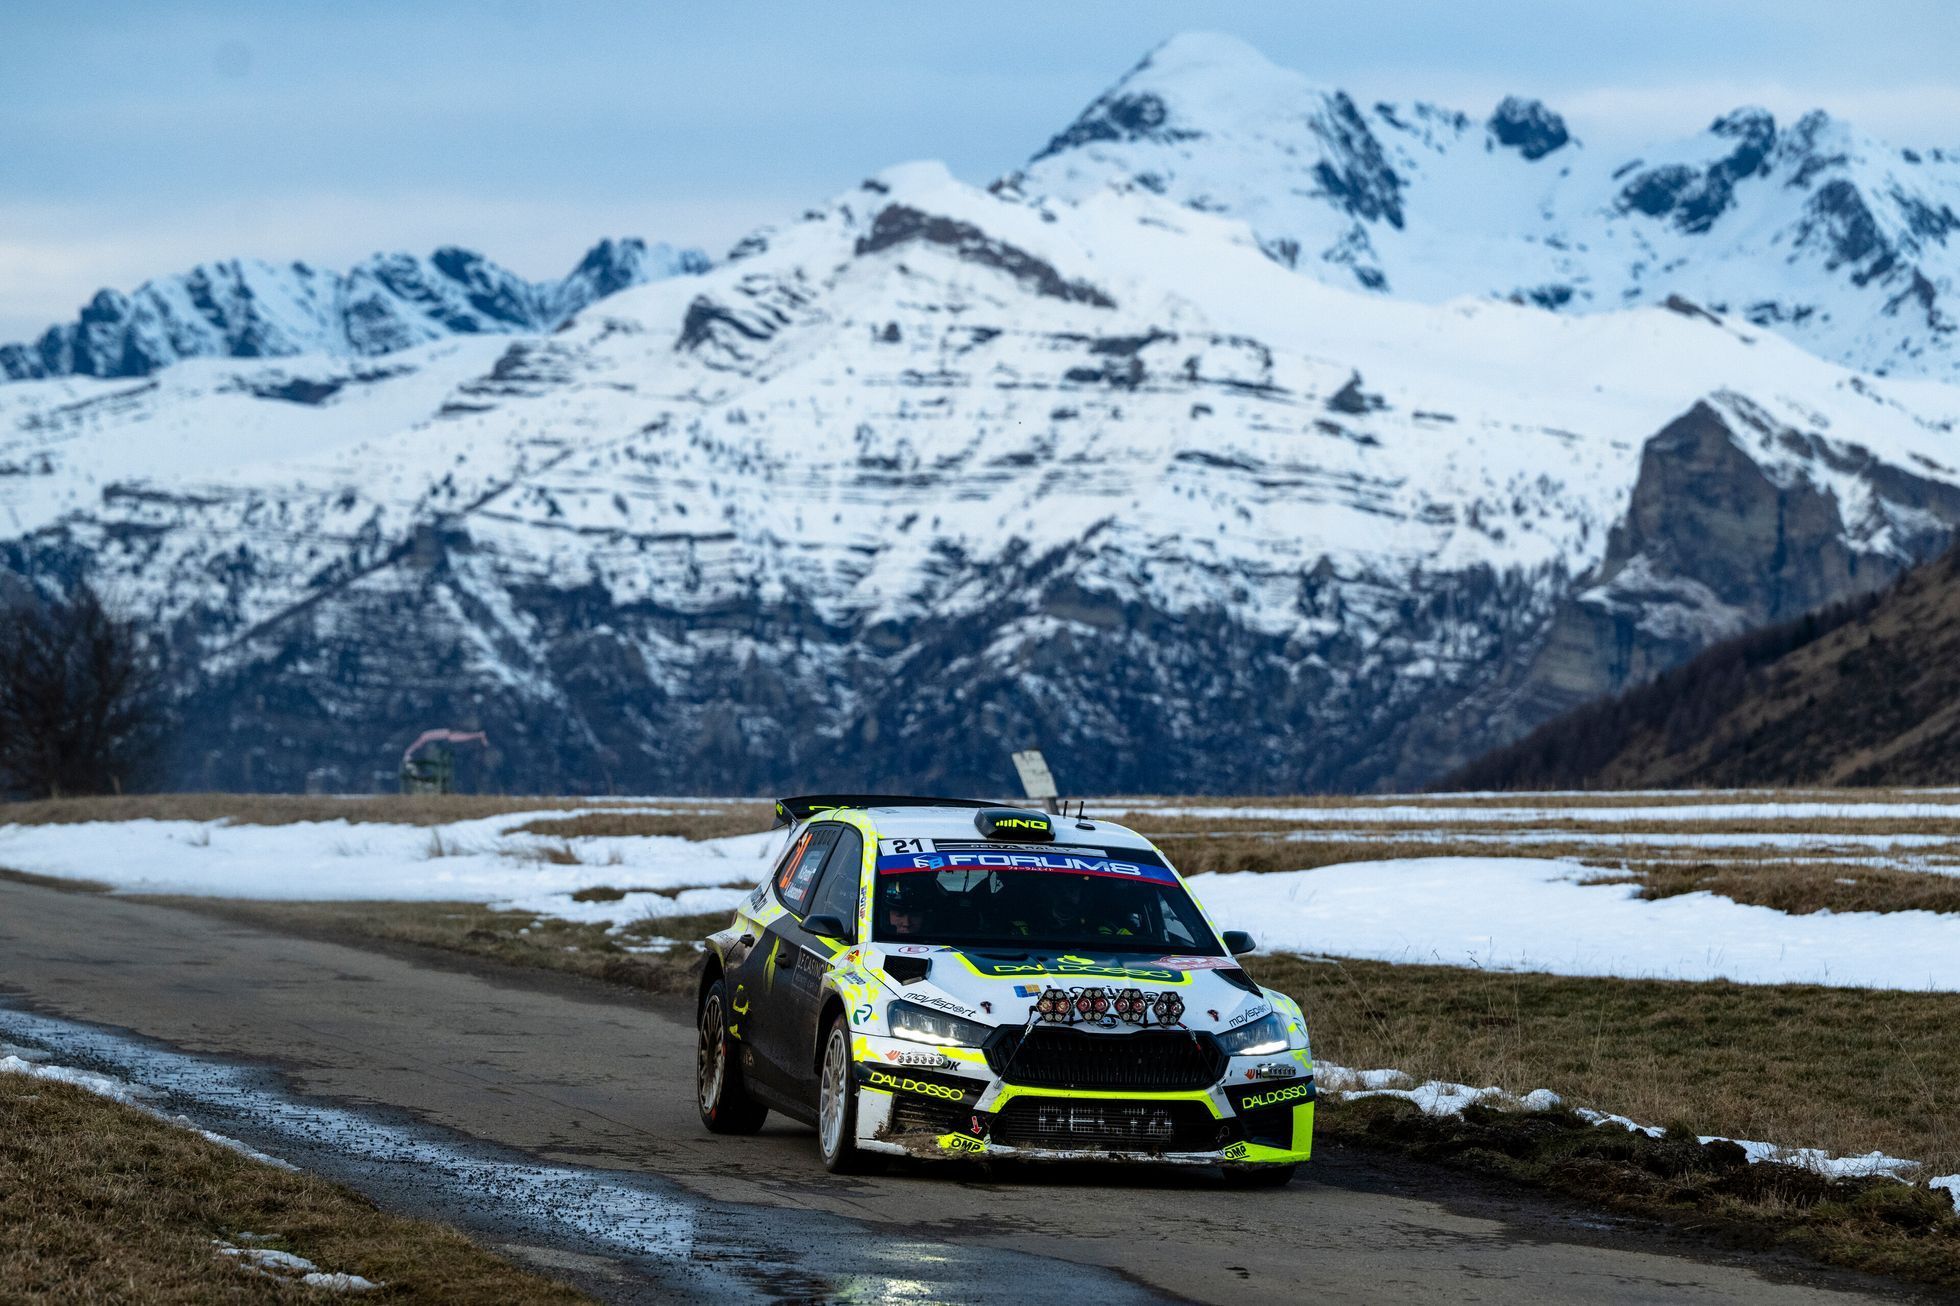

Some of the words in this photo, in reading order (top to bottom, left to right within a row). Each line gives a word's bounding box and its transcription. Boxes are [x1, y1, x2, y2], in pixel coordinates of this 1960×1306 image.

[892, 838, 925, 853] 21
[948, 854, 1142, 876] FORUM8
[951, 1137, 981, 1151] OMP
[1224, 1145, 1247, 1159] OMP
